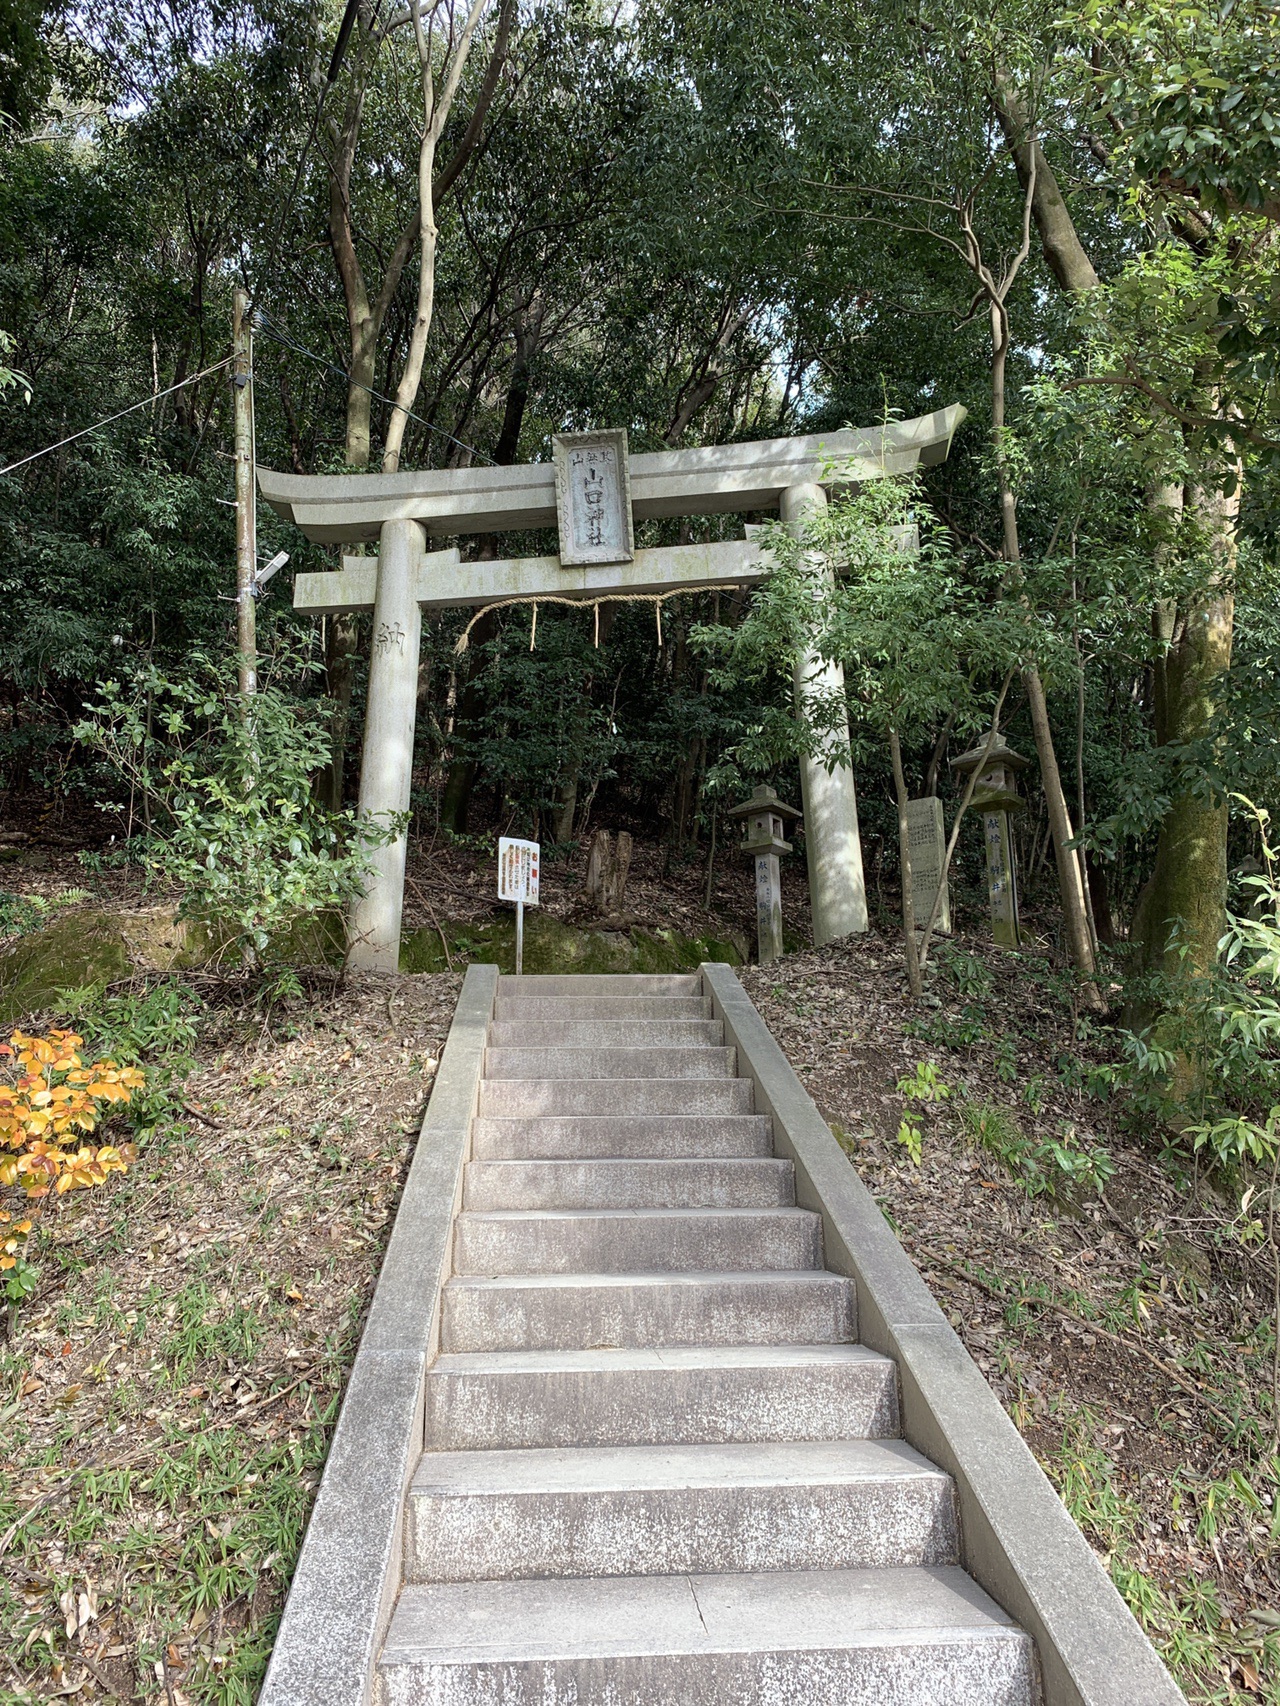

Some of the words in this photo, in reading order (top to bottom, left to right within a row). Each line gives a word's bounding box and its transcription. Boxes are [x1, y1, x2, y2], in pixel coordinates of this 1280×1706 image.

[582, 467, 606, 547] 山口神社
[374, 621, 406, 659] 納
